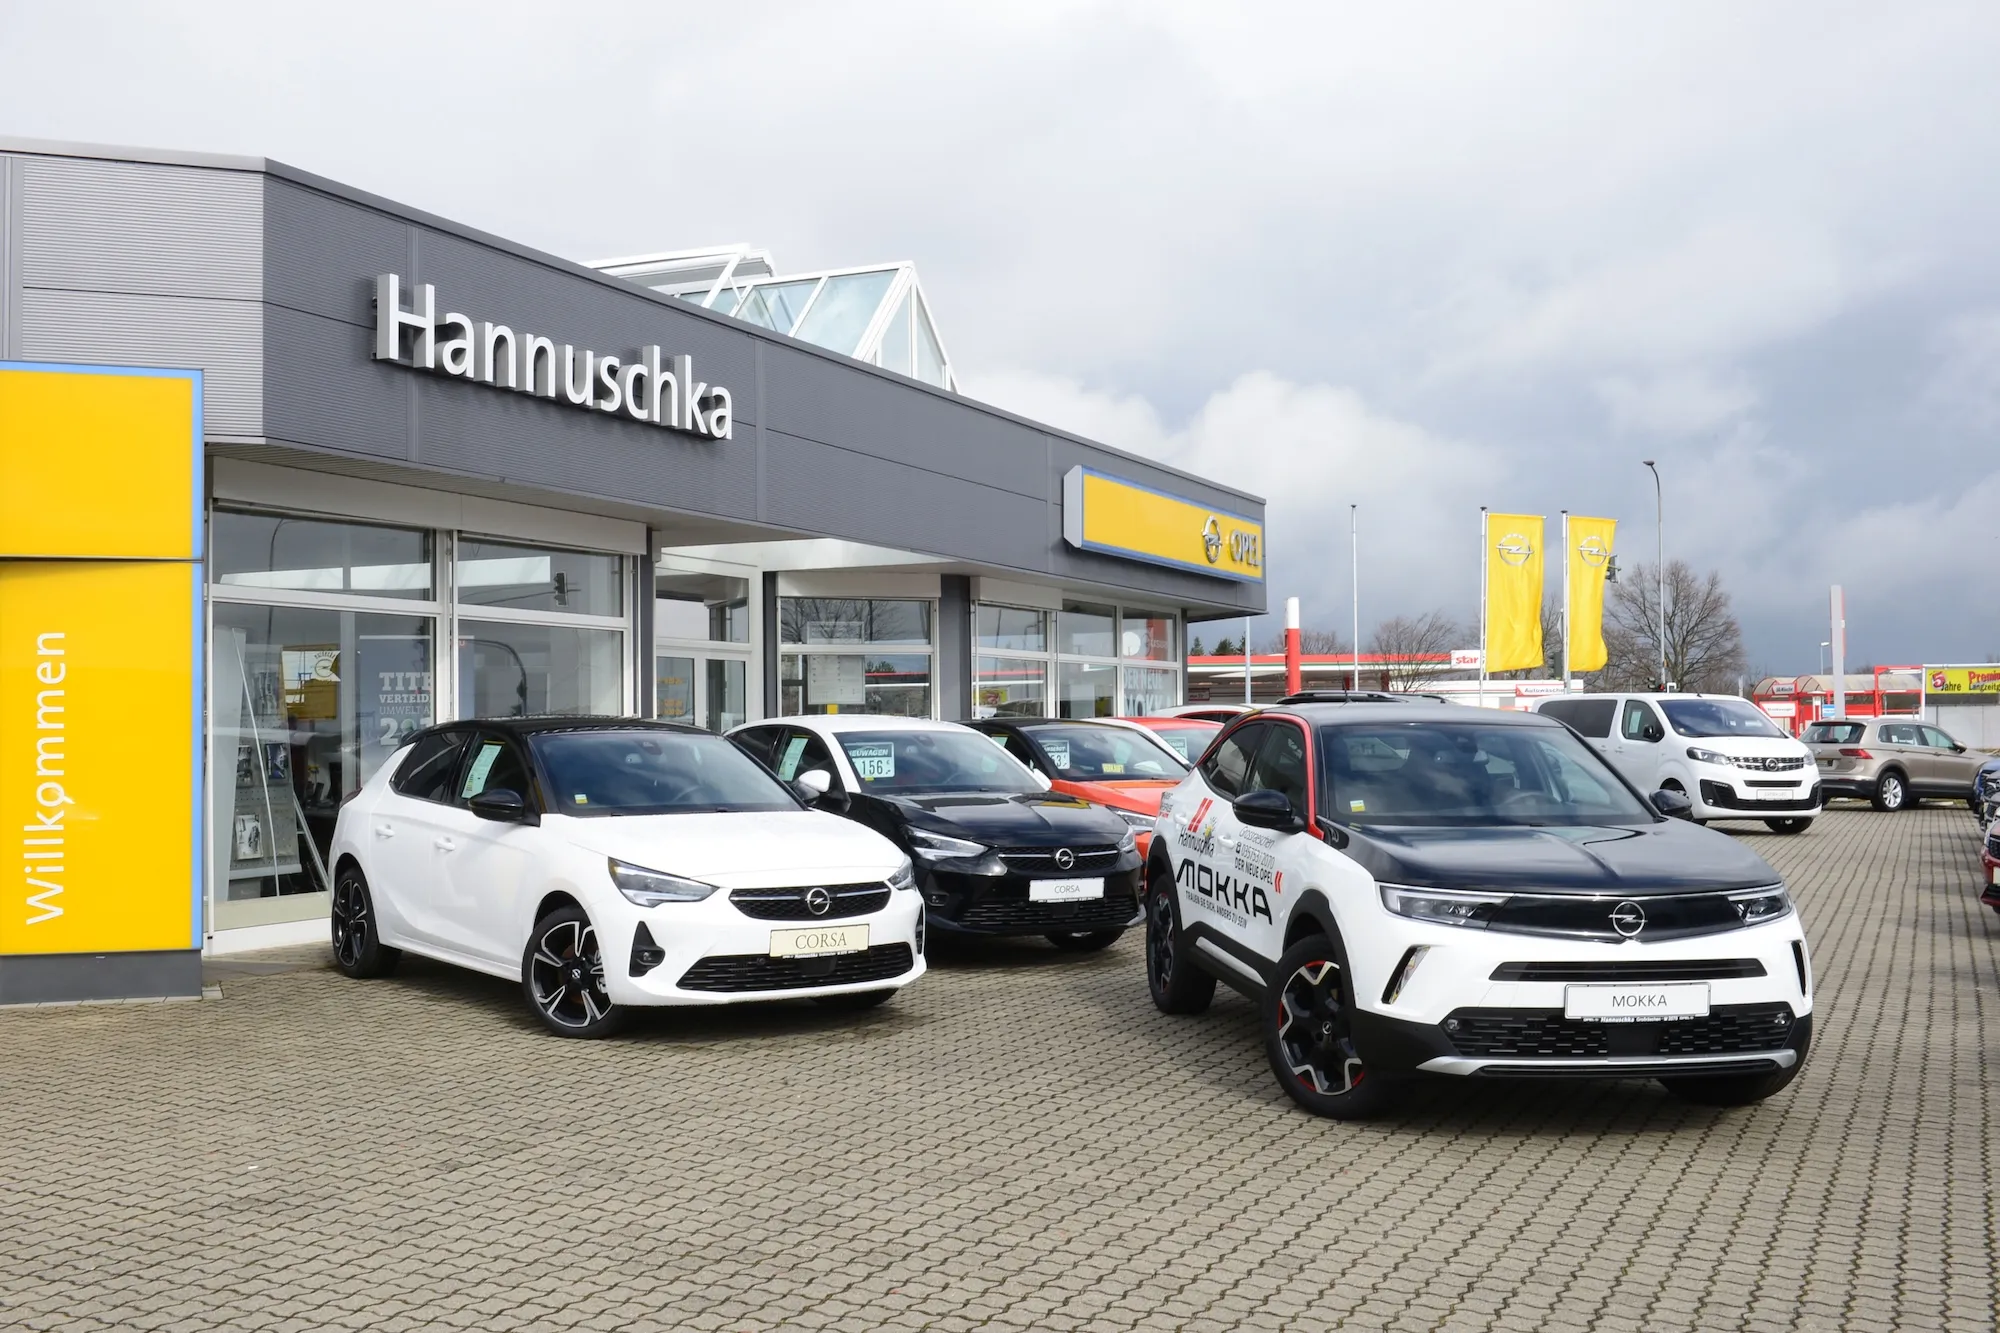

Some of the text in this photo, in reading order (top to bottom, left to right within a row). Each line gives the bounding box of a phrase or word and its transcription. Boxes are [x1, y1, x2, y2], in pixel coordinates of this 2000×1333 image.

[376, 273, 732, 440] Hannuschka
[1230, 529, 1262, 567] OPEL
[1455, 655, 1479, 664] star
[379, 672, 431, 691] TITE
[1141, 668, 1163, 690] NEUE
[1932, 671, 1946, 688] 5
[1968, 670, 2000, 684] Premiu
[1941, 681, 1962, 691] Jahre
[379, 694, 430, 703] VERTEID
[380, 706, 421, 714] UMWELT
[23, 632, 66, 925] Willkommen
[1235, 857, 1273, 885] DER NEUE OPEL
[1054, 885, 1081, 893] CORSA
[1176, 858, 1272, 925] MOKKA
[795, 932, 847, 949] CORSA
[1612, 995, 1668, 1008] MOKKA
